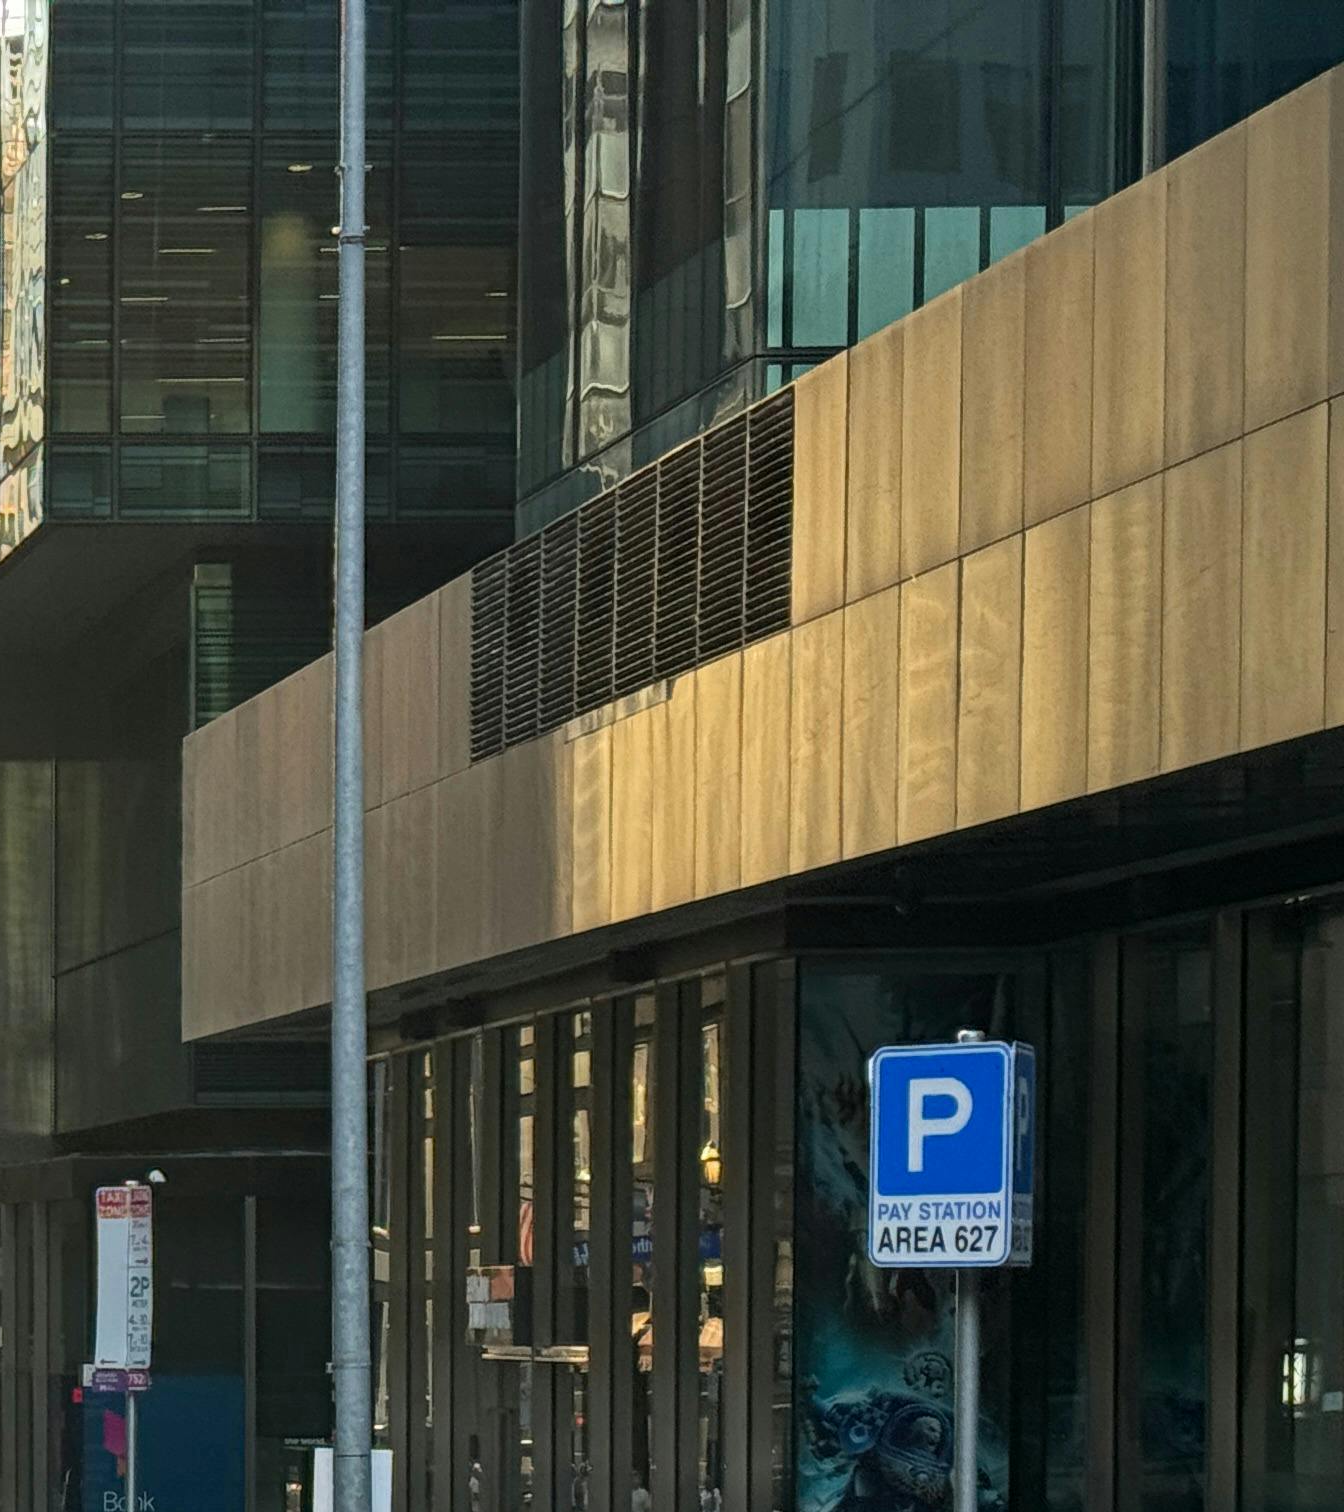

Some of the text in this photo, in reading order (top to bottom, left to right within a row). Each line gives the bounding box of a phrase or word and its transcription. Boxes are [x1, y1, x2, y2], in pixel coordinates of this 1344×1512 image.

[878, 1203, 912, 1221] PAY
[918, 1200, 1001, 1220] STATION
[878, 1226, 946, 1253] AREA
[955, 1225, 999, 1252] 627
[130, 1276, 150, 1298] 2P
